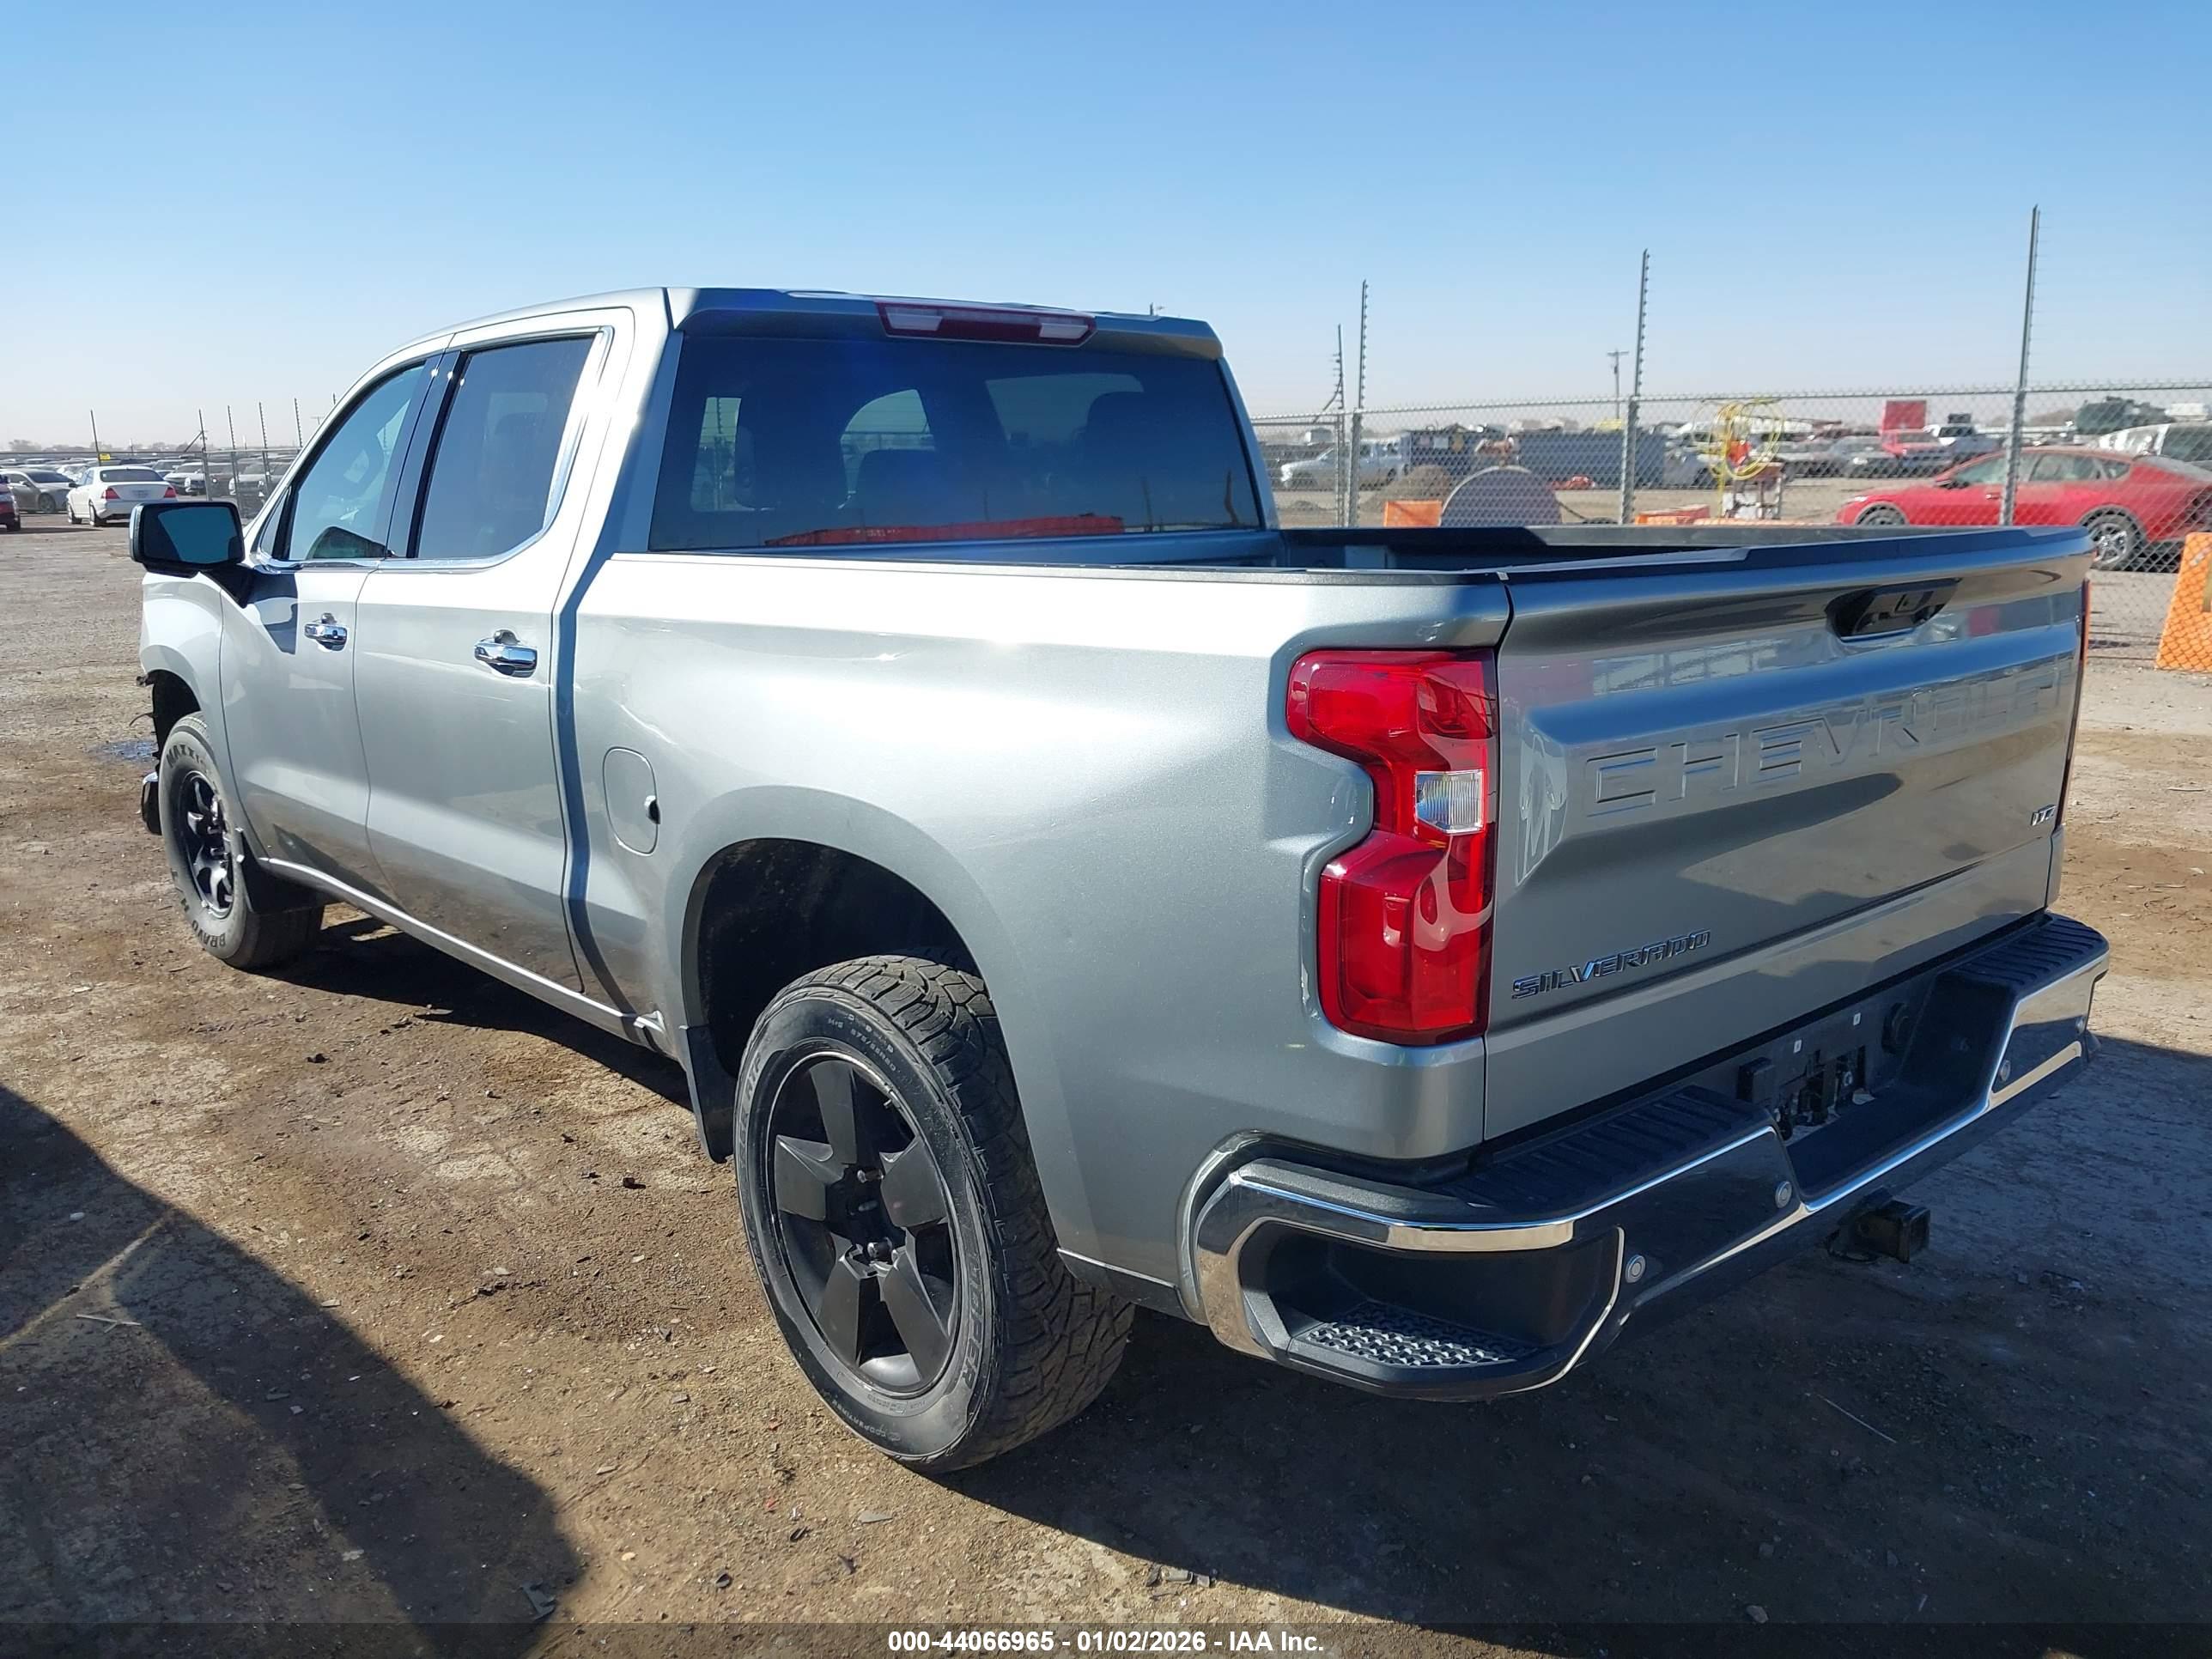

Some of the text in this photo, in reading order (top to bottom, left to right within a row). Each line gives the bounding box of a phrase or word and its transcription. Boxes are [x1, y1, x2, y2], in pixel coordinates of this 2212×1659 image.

[1585, 658, 2073, 817] CHEVROLET
[191, 920, 226, 948] BRAVO
[1511, 928, 1711, 1000] SILVERADO
[960, 1226, 983, 1390] OOPER
